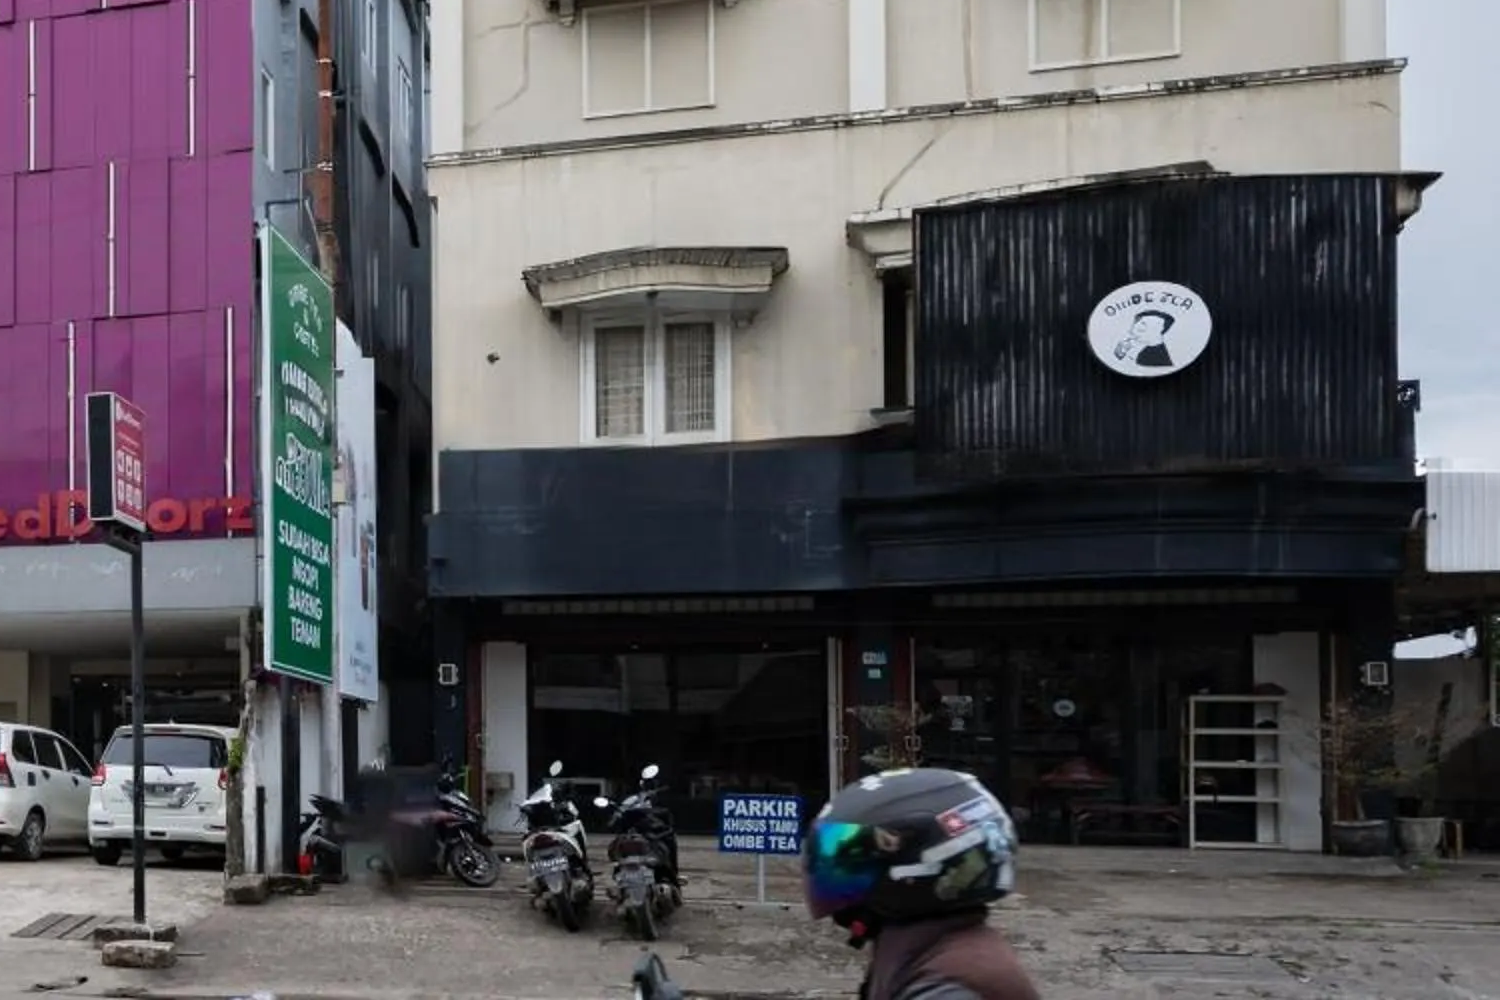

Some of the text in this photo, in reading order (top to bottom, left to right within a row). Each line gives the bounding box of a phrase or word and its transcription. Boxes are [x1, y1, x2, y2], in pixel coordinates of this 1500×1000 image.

[723, 799, 797, 817] PARKIR
[723, 818, 767, 833] KHUSUS
[723, 834, 797, 851] OMBE TEA
